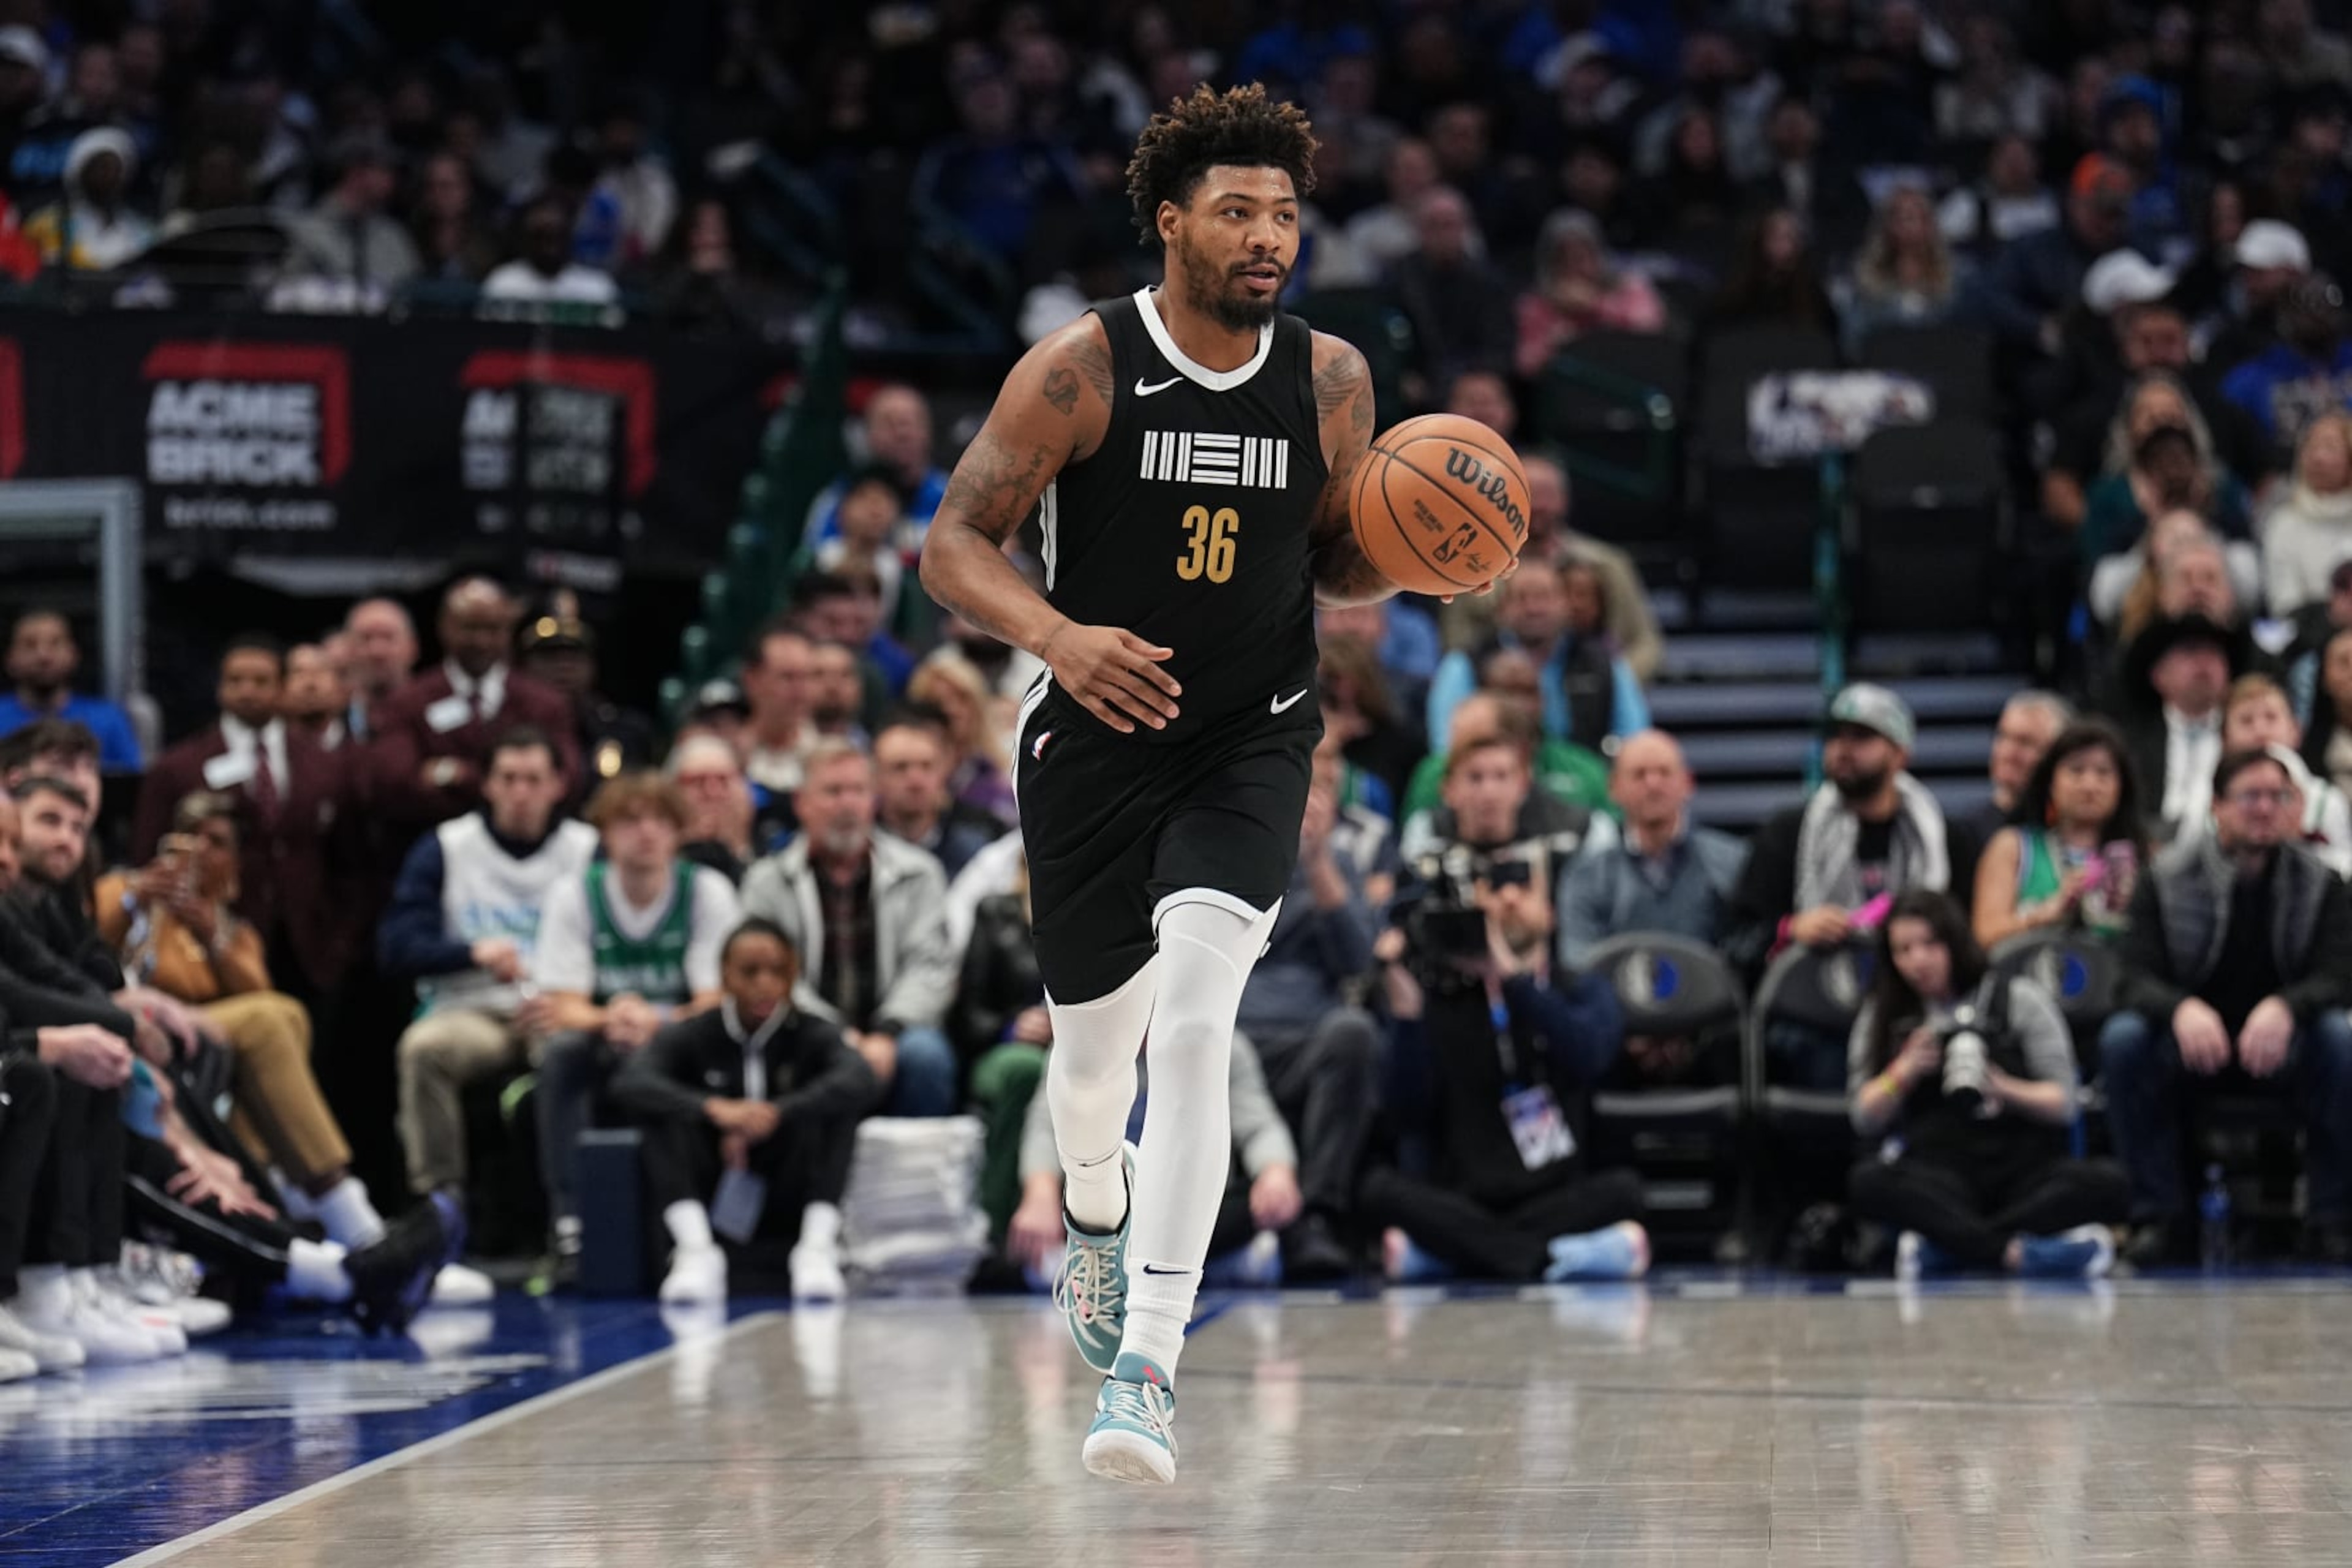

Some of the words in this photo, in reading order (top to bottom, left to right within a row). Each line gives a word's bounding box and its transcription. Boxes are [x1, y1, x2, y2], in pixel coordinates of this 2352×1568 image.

[148, 381, 320, 428] ACME
[148, 436, 320, 485] BRICK
[1446, 447, 1525, 540] Wilson
[1177, 505, 1239, 584] 36
